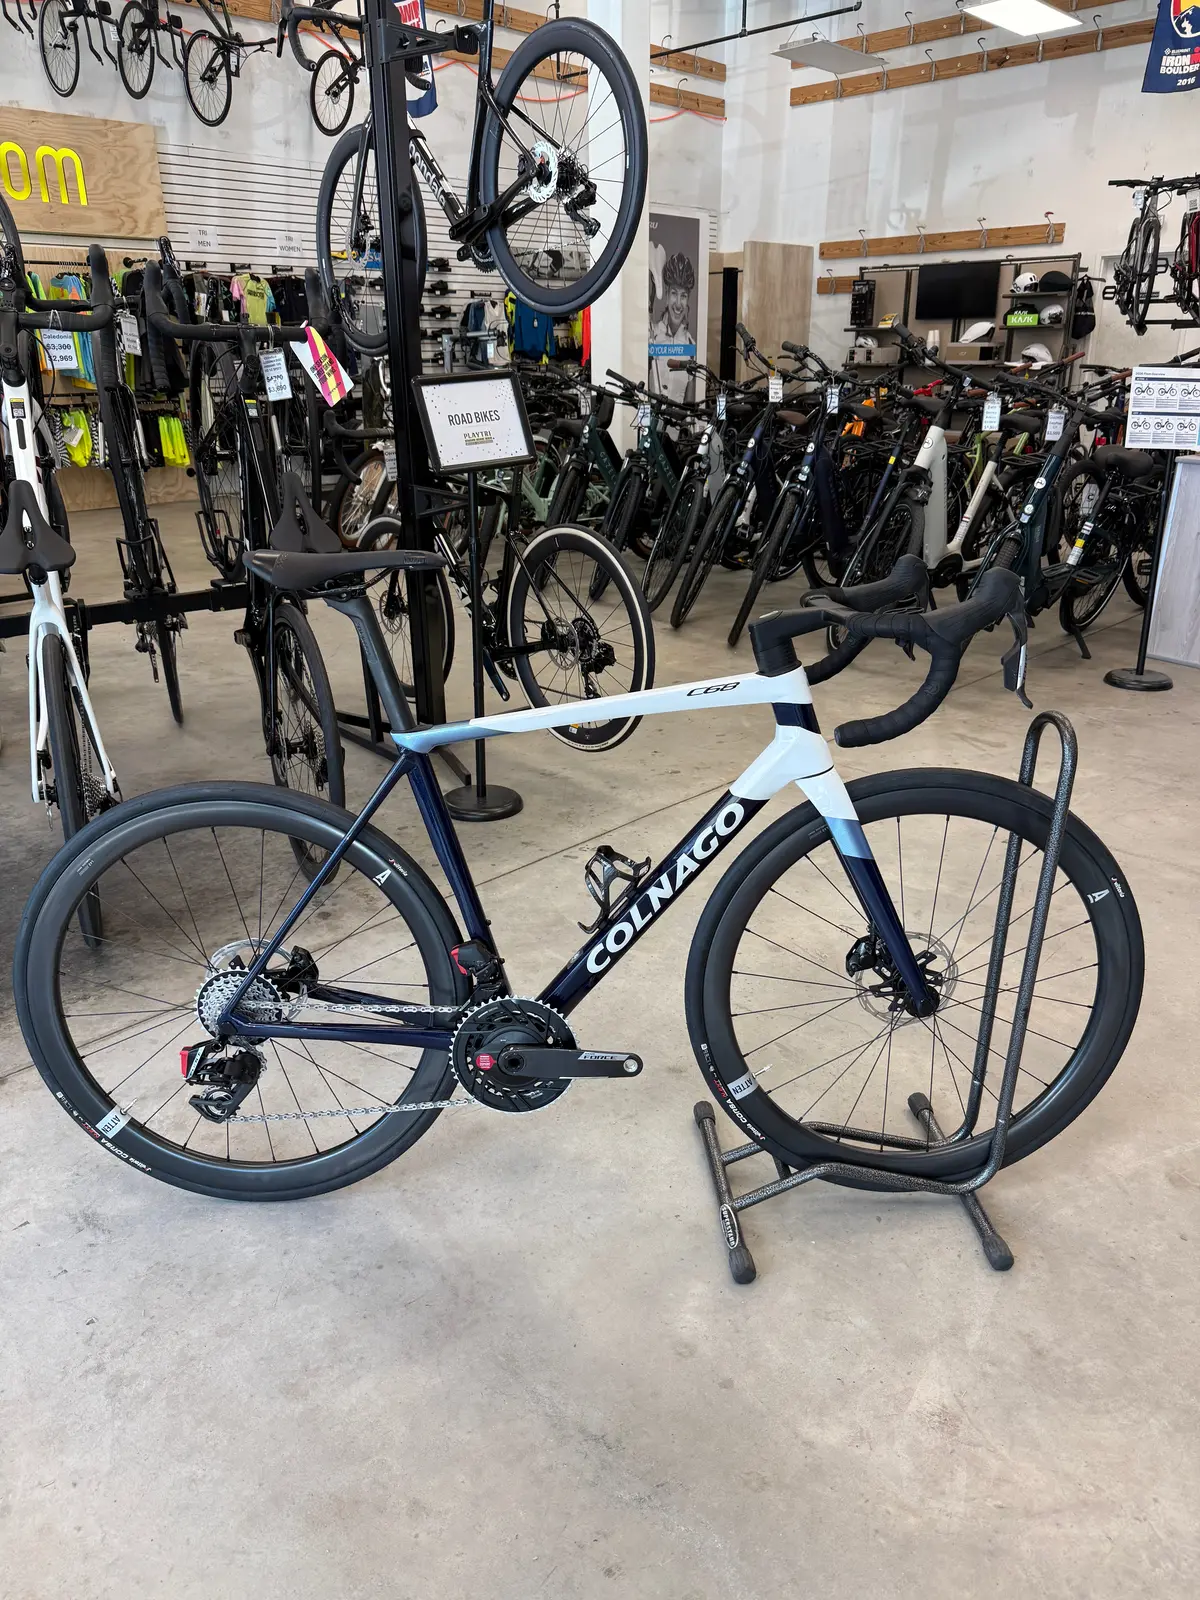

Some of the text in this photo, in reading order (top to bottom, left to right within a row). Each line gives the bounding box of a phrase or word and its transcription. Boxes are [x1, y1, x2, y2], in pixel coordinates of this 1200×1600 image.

[1160, 63, 1200, 75] BOULDER
[1176, 76, 1196, 86] 2016
[1011, 316, 1033, 324] KASK
[447, 409, 501, 426] ROAD BIKES
[463, 430, 492, 439] PLAYTRI
[586, 802, 745, 975] COLNAGO
